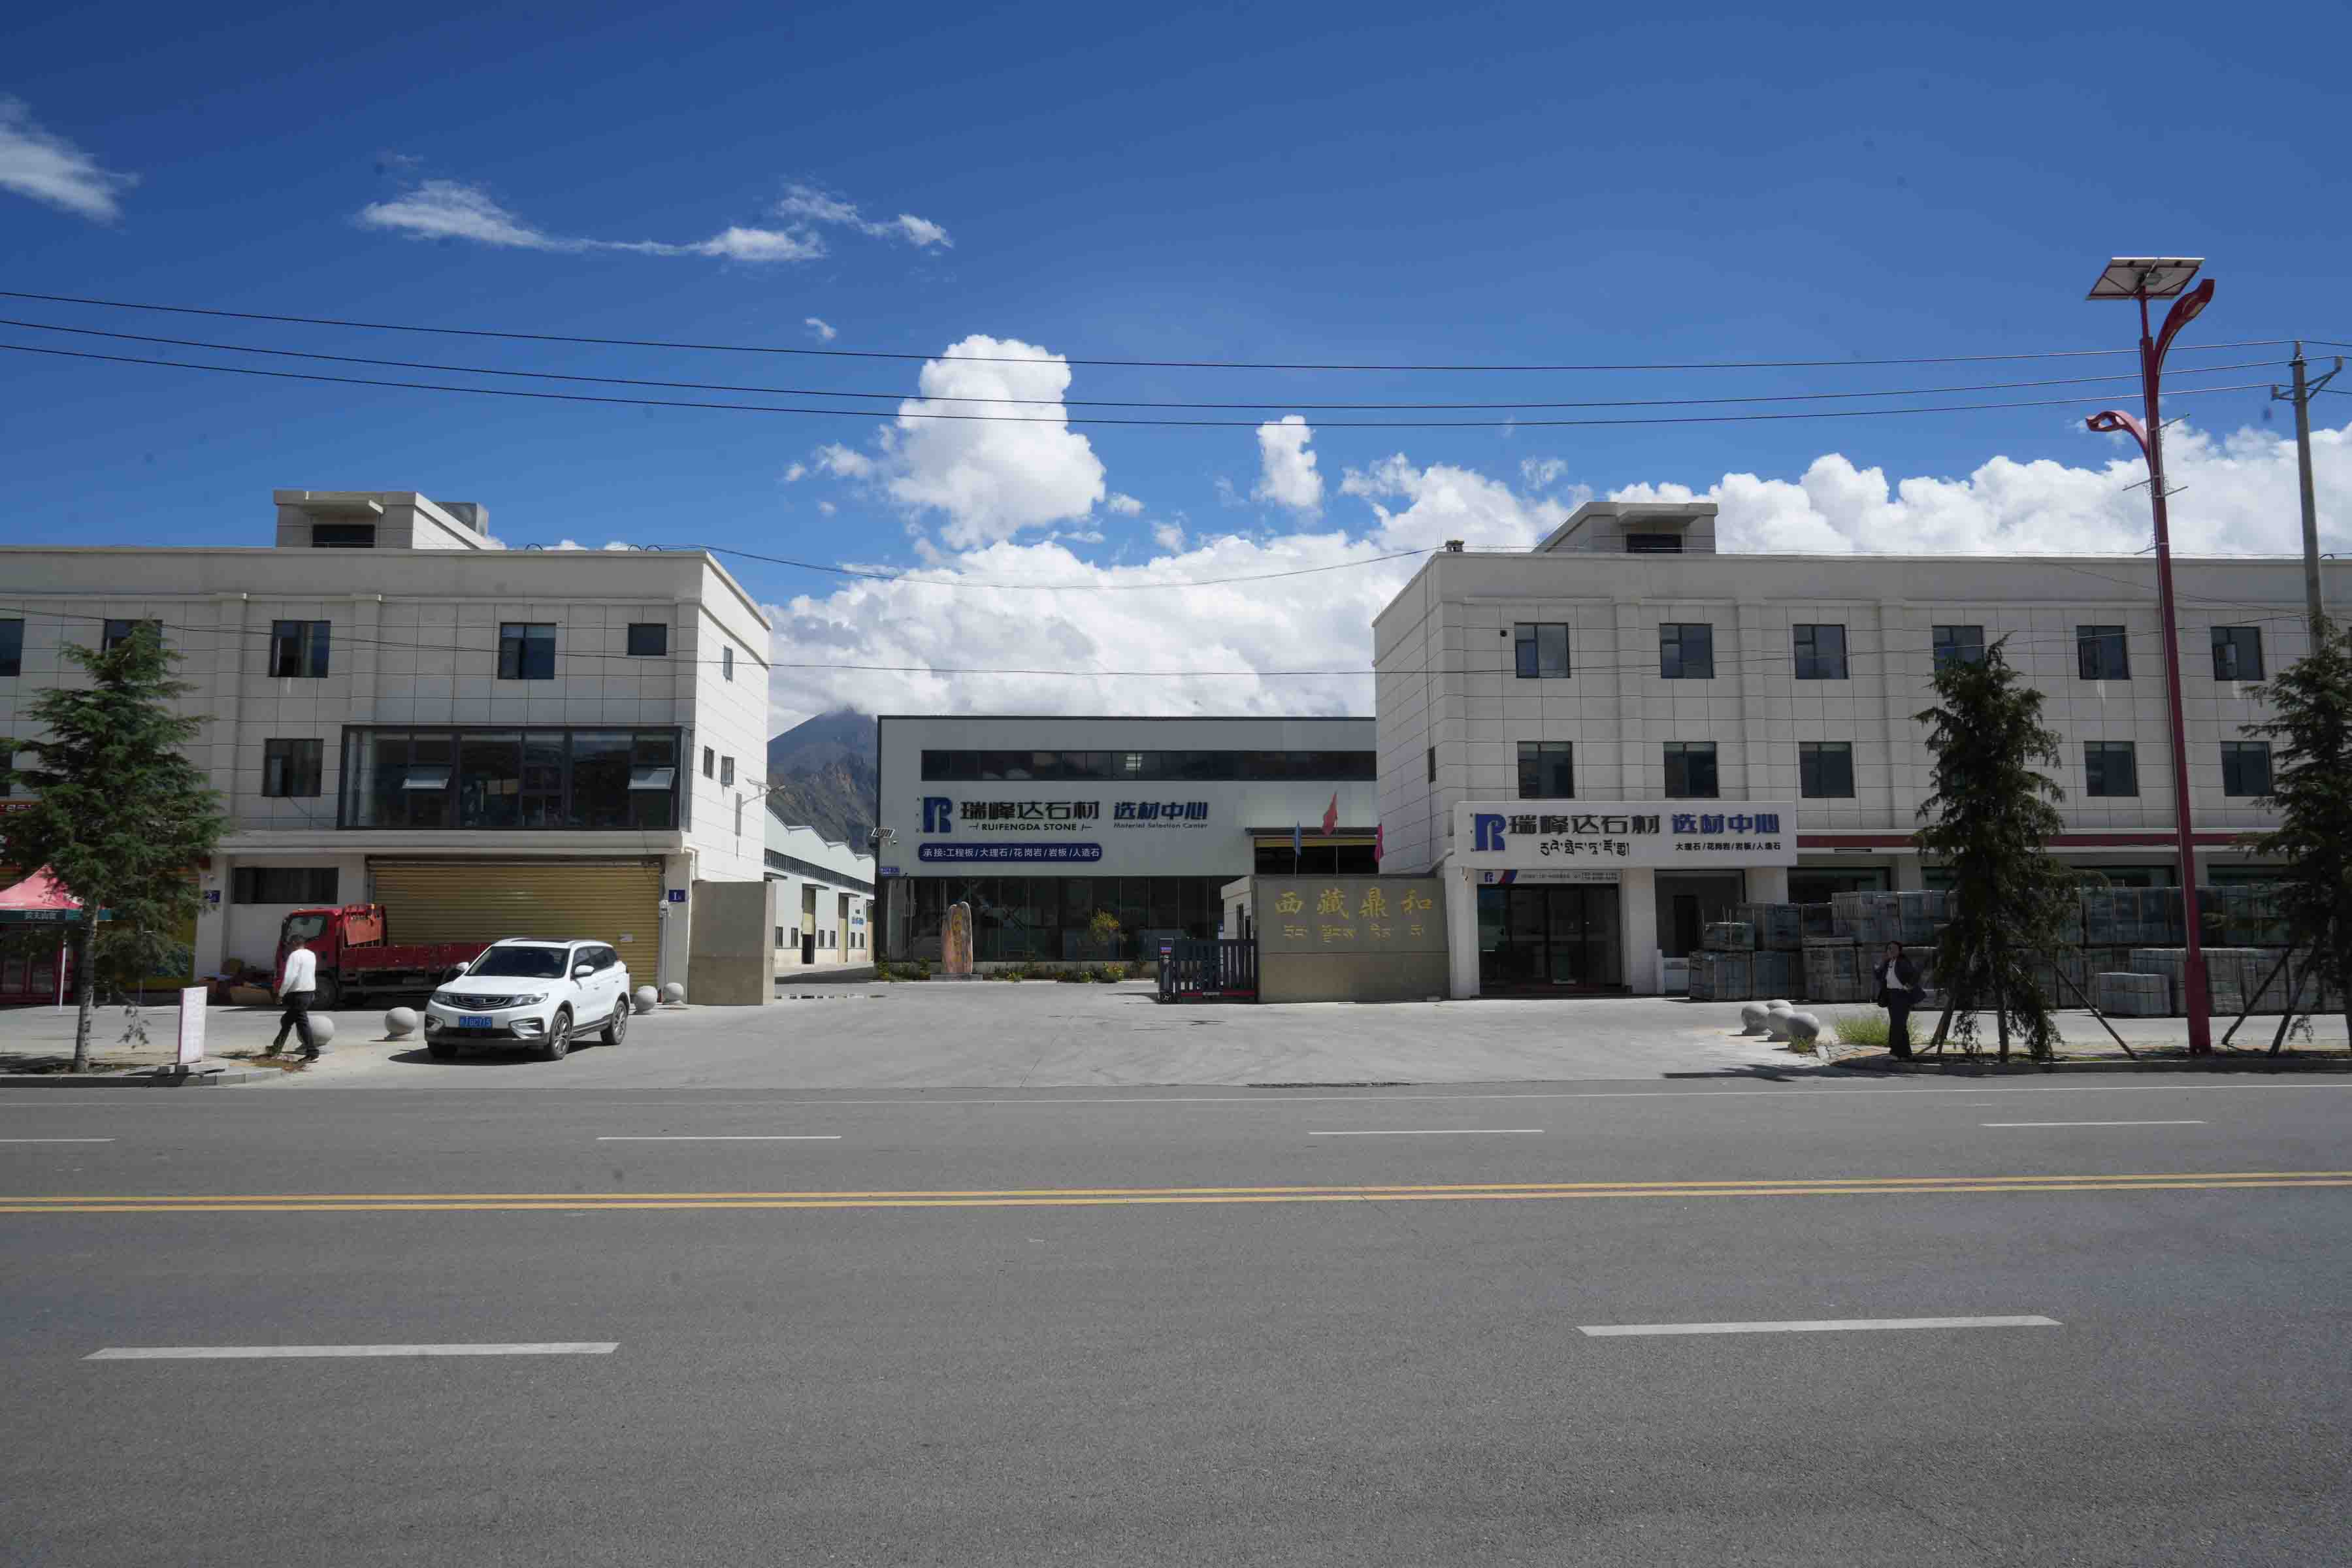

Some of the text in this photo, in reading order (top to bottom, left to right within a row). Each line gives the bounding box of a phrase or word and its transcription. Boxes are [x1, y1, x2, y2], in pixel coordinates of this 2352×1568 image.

[960, 801, 1208, 820] 瑞峰达石材 选材中心
[1043, 823, 1077, 831] STONE
[1509, 814, 1780, 835] 瑞峰达石材 选材中心
[1275, 887, 1433, 920] 西藏鼎和
